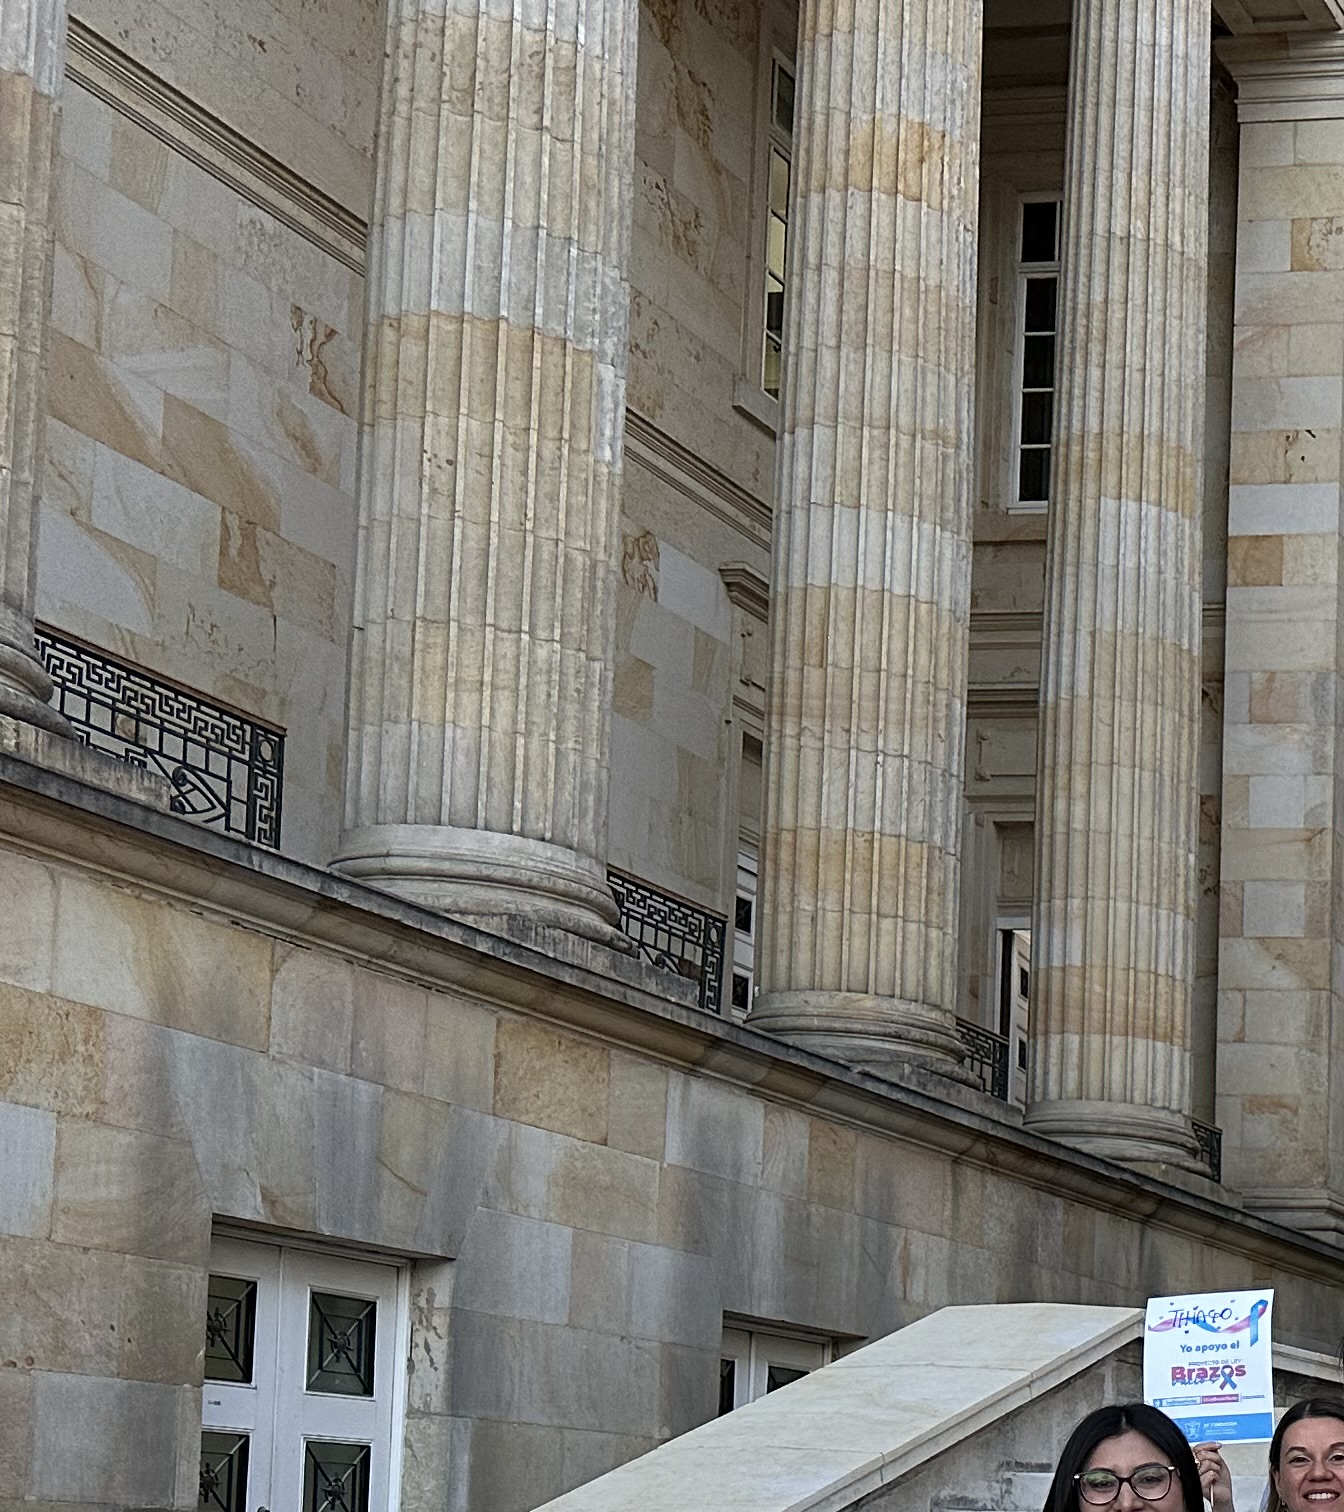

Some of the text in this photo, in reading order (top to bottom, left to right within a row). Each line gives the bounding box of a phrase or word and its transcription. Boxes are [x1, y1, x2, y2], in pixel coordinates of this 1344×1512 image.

[1180, 1340, 1240, 1353] Yo apoyo el
[1171, 1364, 1246, 1379] Brazos
